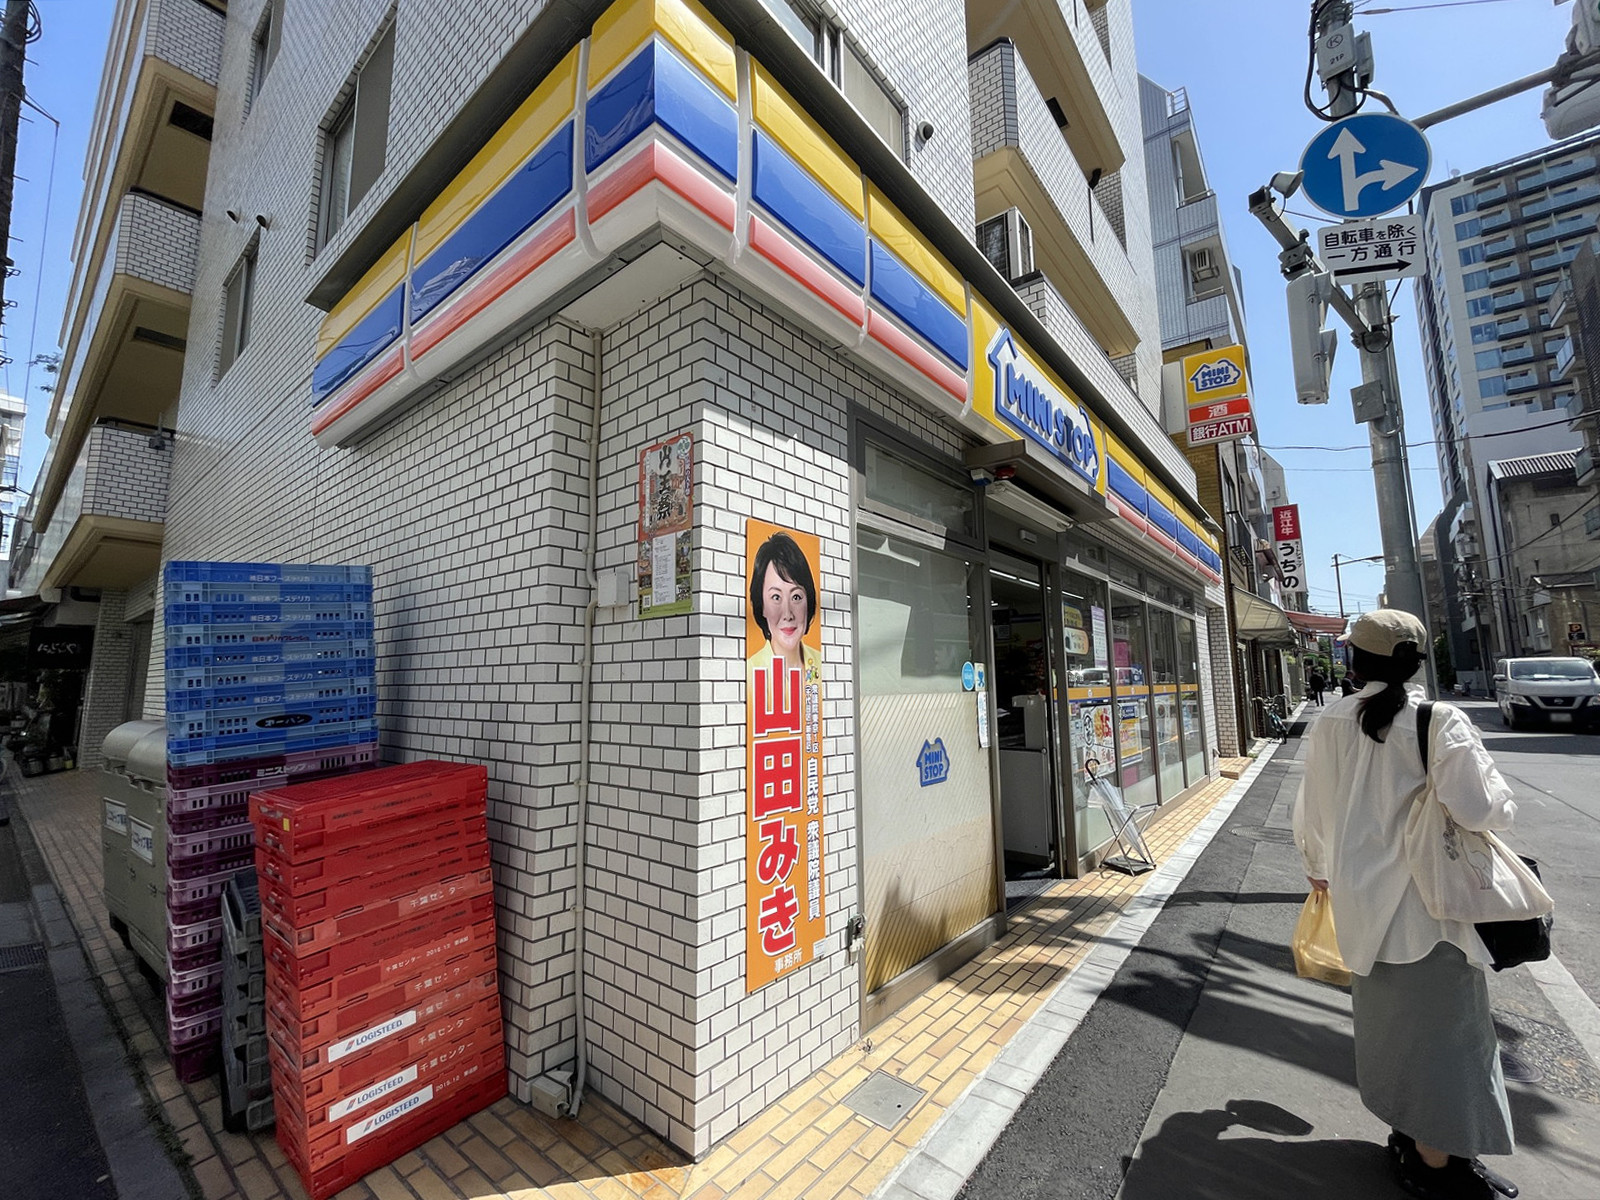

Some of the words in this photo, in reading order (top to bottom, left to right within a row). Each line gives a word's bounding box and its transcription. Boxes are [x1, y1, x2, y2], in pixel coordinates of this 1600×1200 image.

[1325, 224, 1417, 247] 自転車を除く
[1327, 241, 1417, 262] 一方通行
[1201, 366, 1230, 379] MINI
[1201, 374, 1232, 388] STOP
[1006, 362, 1053, 438] MINI
[1054, 407, 1096, 468] STOP
[1208, 403, 1228, 418] 酒
[1192, 419, 1249, 440] 銀行ATM
[1280, 510, 1294, 536] 近江牛
[1279, 542, 1300, 589] うちの
[924, 750, 943, 766] MINI
[924, 763, 944, 780] STOP
[806, 757, 819, 816] 自民党
[753, 656, 802, 957] 山田みき
[806, 820, 821, 922] 衆議院議員
[774, 948, 803, 974] 事務所
[356, 1019, 403, 1047] LOGISTEED
[418, 1016, 473, 1046] 千葉センター
[420, 1041, 474, 1073] 千葉センター
[357, 1076, 404, 1105] LOGISTEED
[374, 1096, 420, 1126] LOGISTEED
